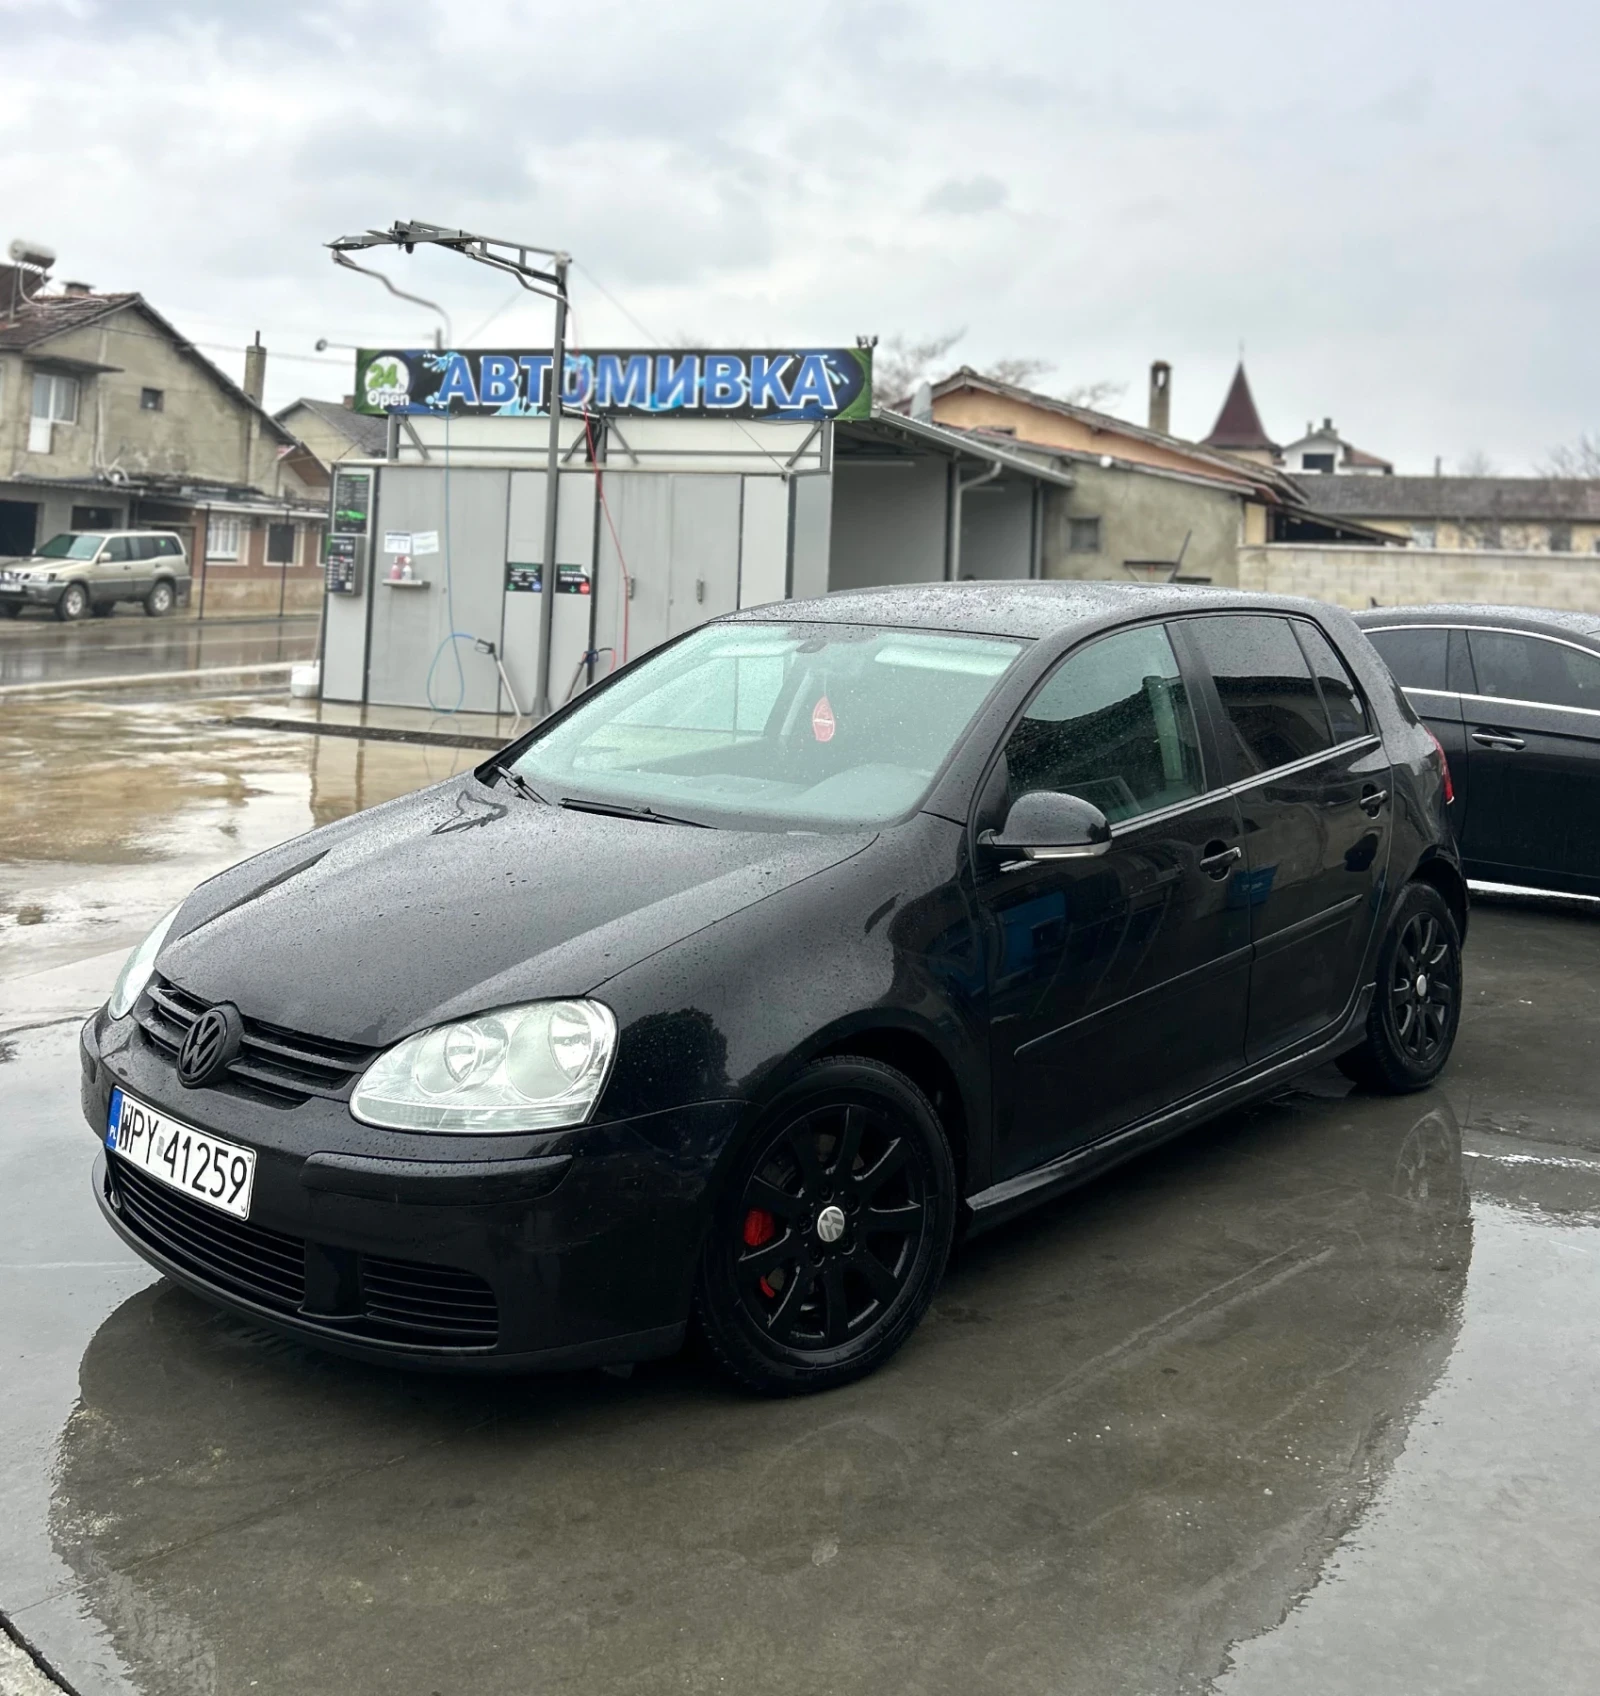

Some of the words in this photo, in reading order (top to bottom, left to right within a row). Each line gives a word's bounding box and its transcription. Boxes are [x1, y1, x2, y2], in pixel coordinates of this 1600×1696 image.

[366, 390, 410, 410] Open
[437, 354, 838, 410] АВТОМИВКА
[109, 1125, 117, 1140] PL
[118, 1100, 160, 1165] WPY
[163, 1130, 248, 1204] 41259
